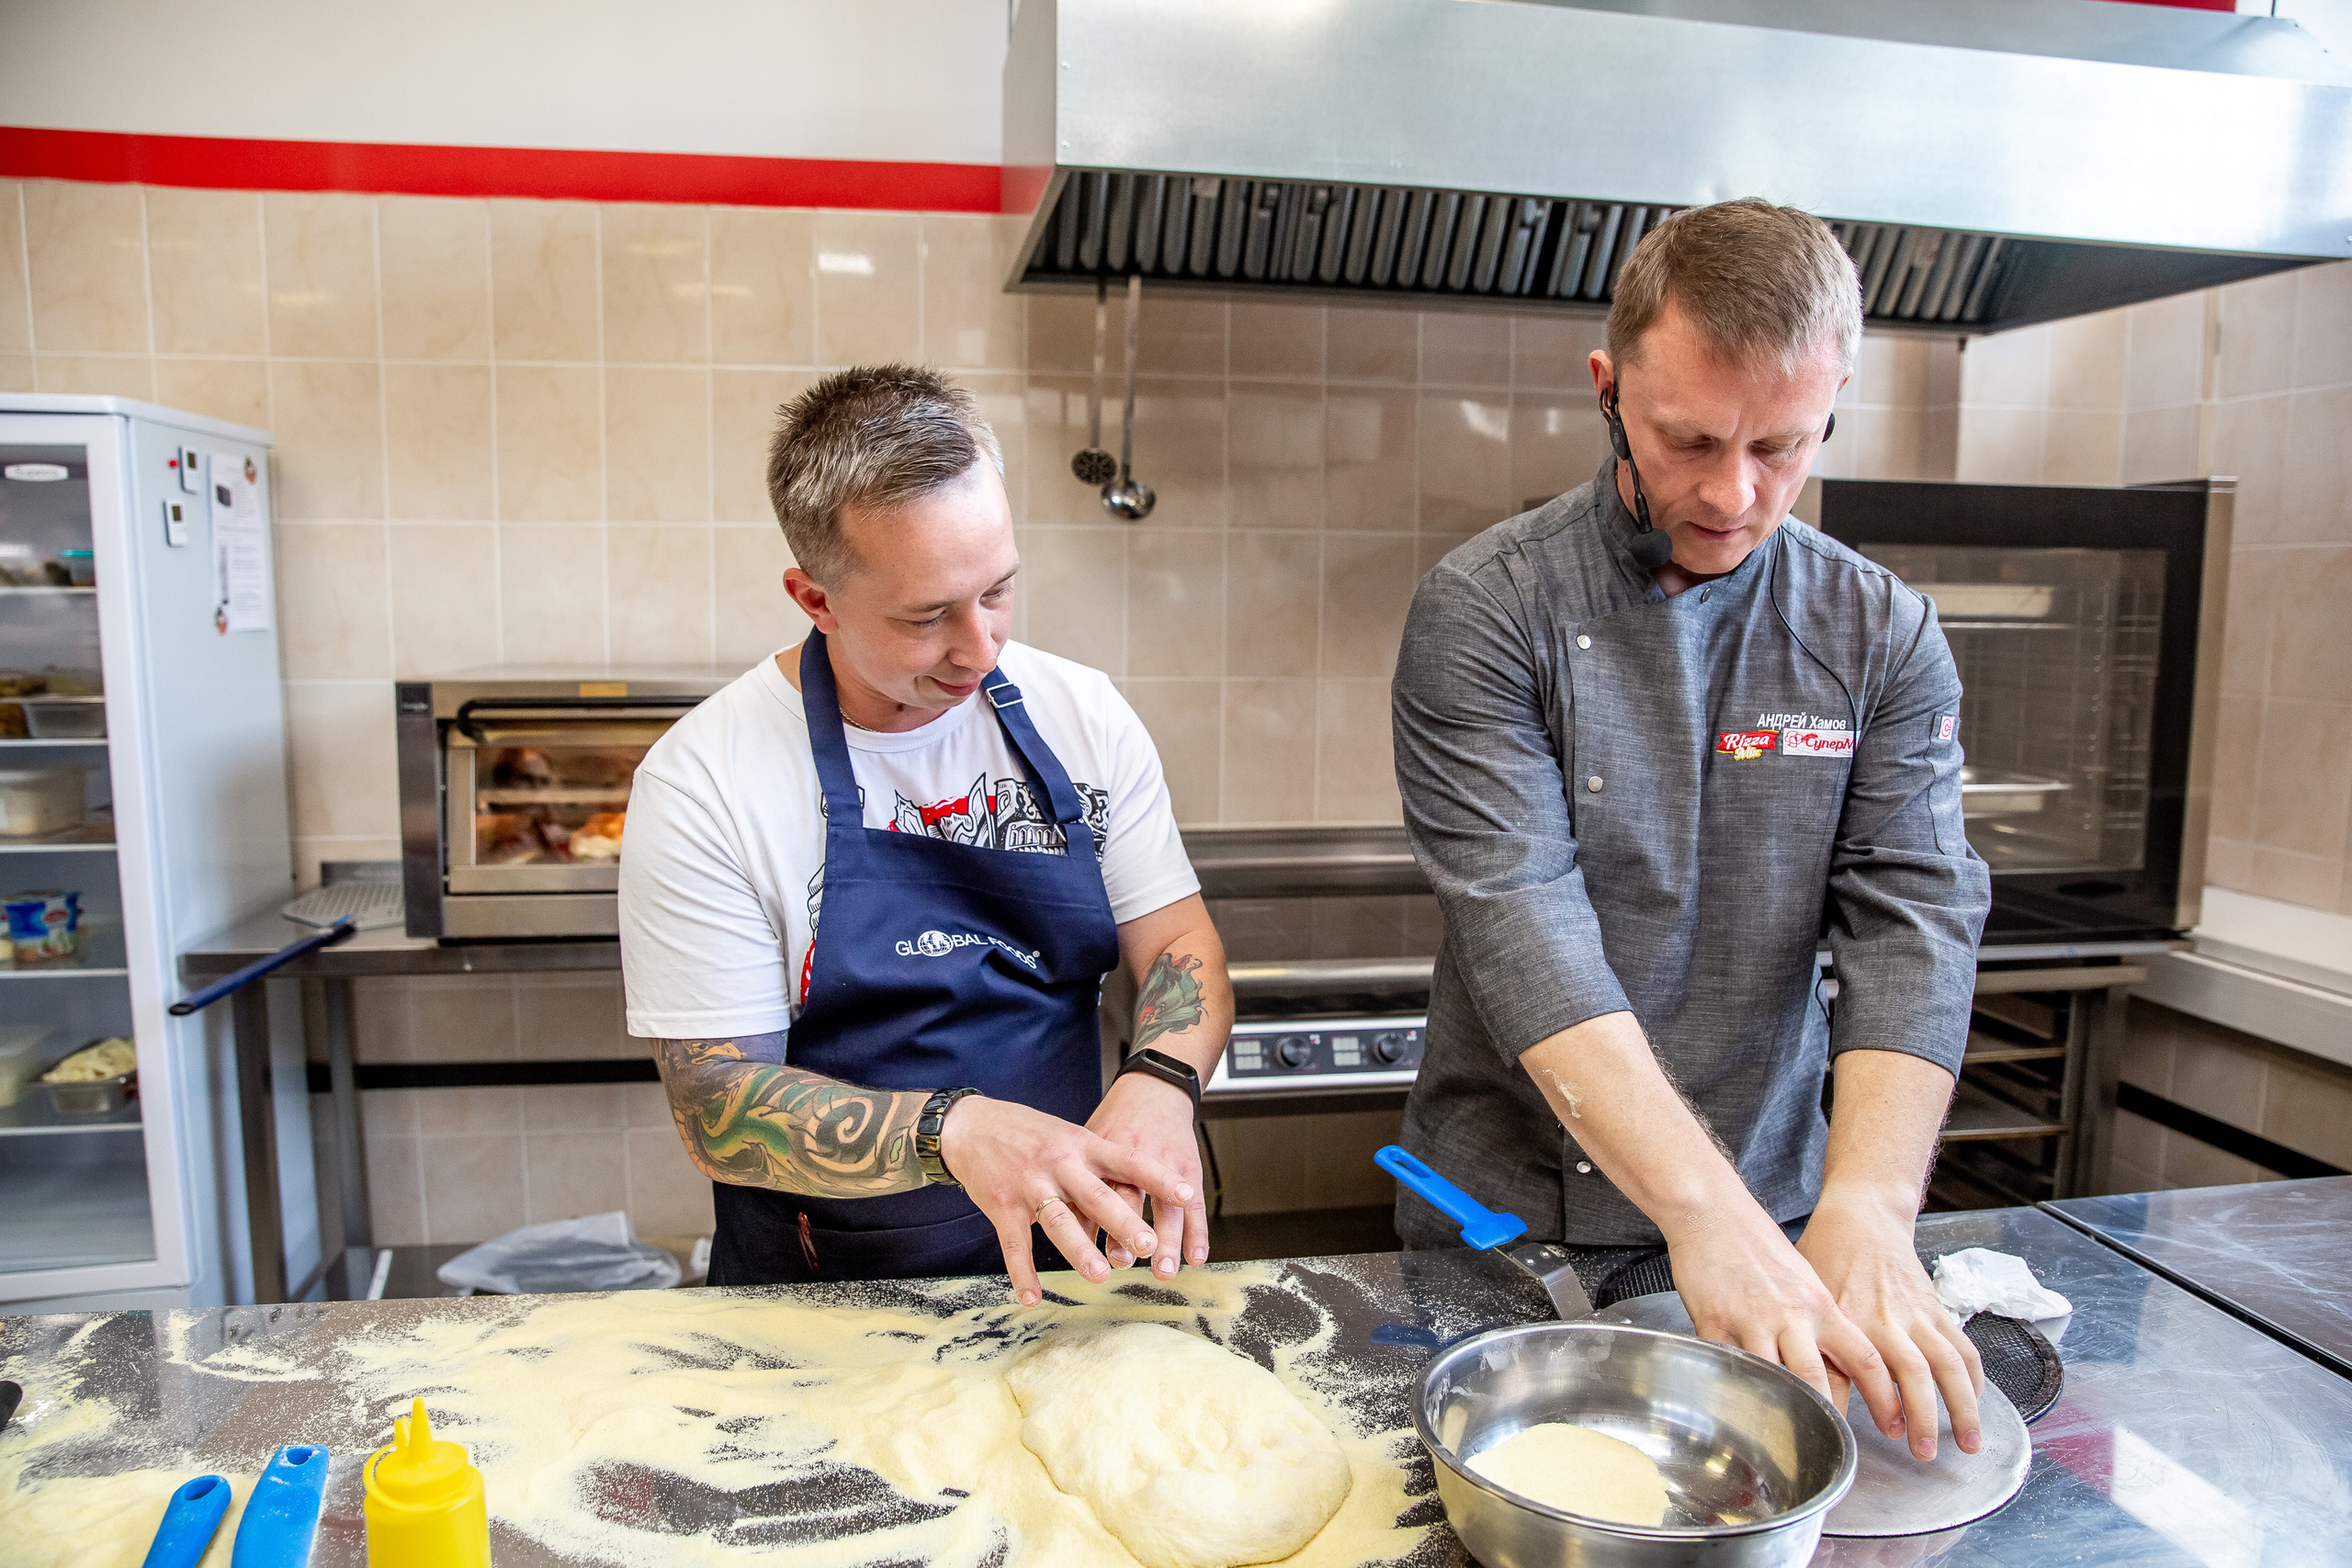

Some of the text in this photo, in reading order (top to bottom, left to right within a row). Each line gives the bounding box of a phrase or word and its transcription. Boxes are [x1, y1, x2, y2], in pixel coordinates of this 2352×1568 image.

[1756, 712, 1846, 730] АНДРЕЙ Хамов
[1724, 733, 1770, 750] Rizza
[896, 931, 988, 956] GLOBAL
